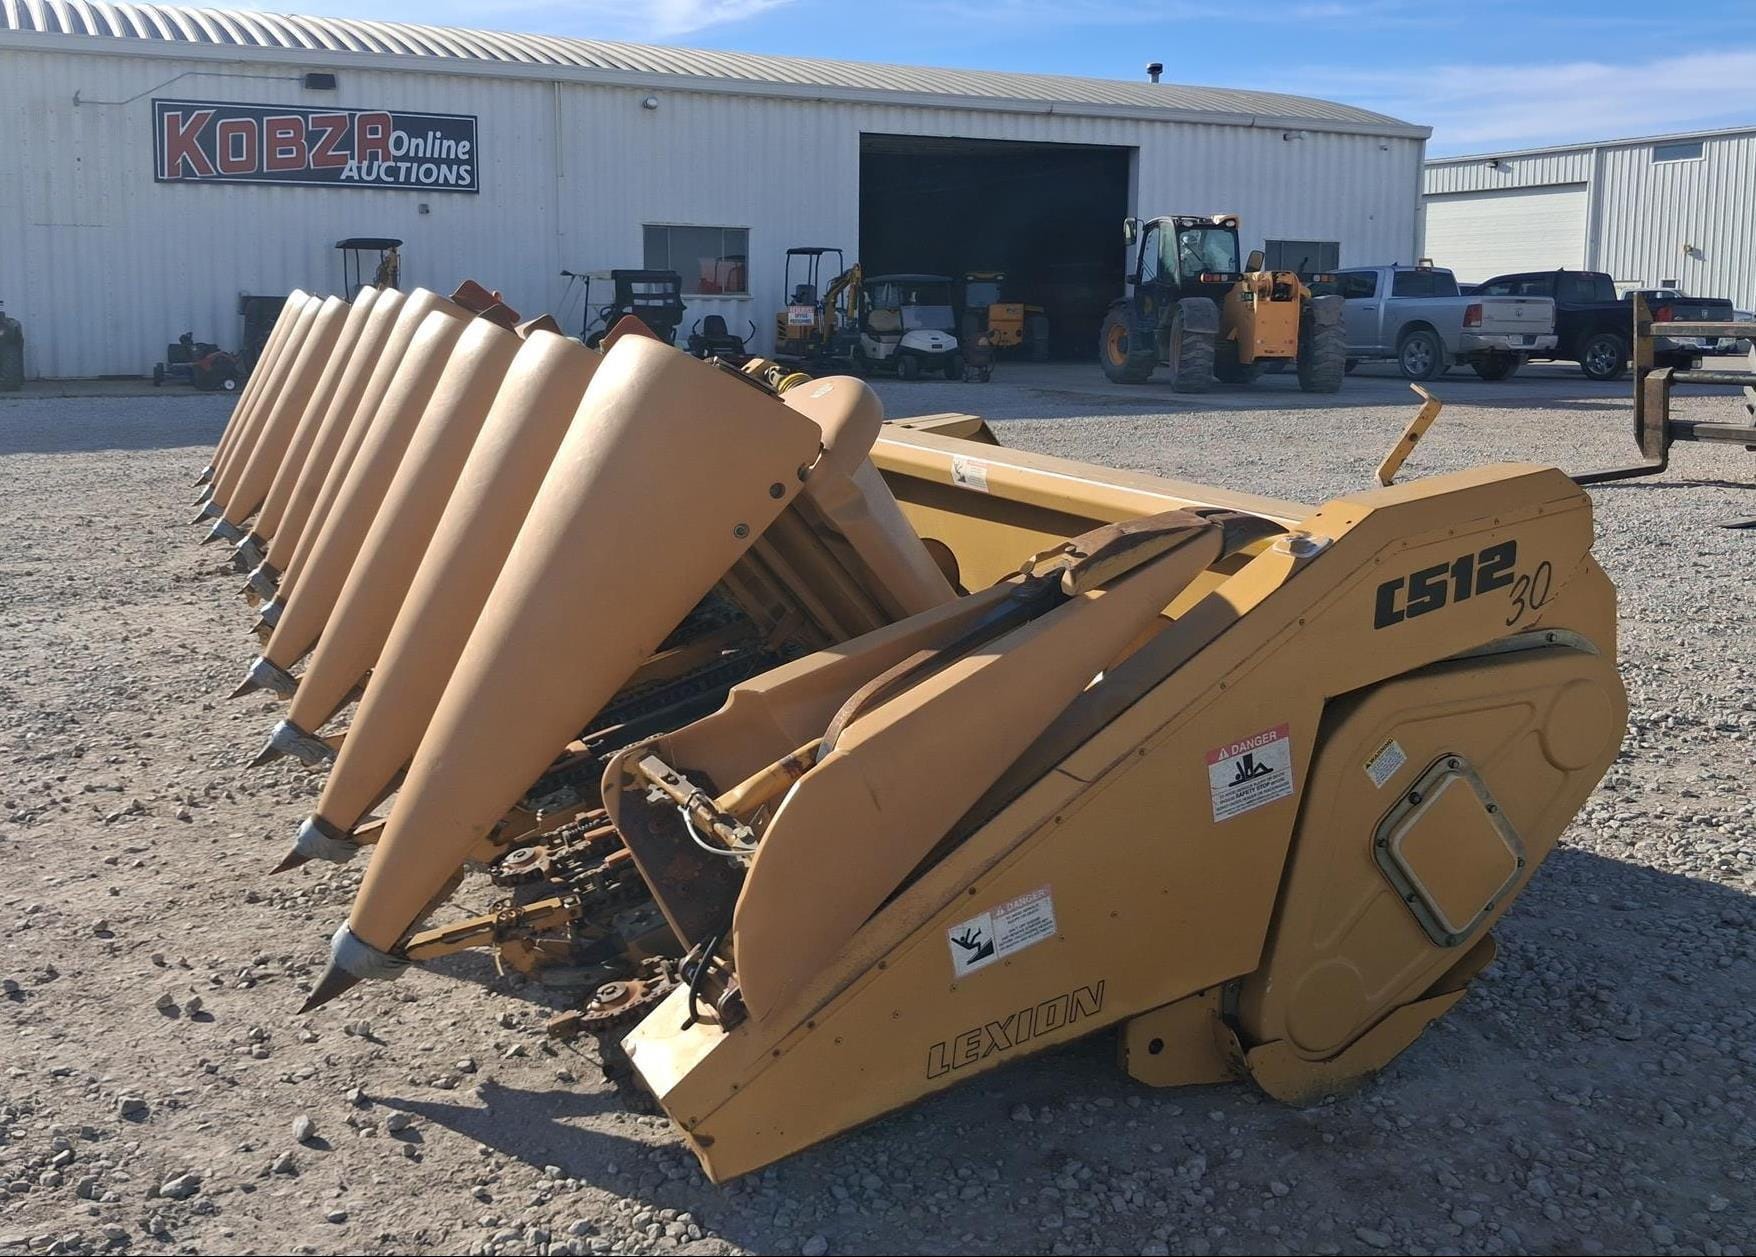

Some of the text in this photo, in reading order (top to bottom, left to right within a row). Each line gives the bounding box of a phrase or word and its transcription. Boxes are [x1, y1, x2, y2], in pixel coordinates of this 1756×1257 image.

[163, 109, 393, 179] KOBZA
[388, 130, 470, 160] Online
[340, 160, 472, 186] AUCTIONS
[1374, 539, 1518, 630] C512
[1505, 560, 1553, 627] 30
[1231, 730, 1277, 756] DANGER
[1369, 738, 1394, 764] WARNING
[1235, 782, 1270, 799] SAFETY STOP
[1007, 888, 1047, 909] DANGER
[926, 979, 1106, 1080] LEXION
